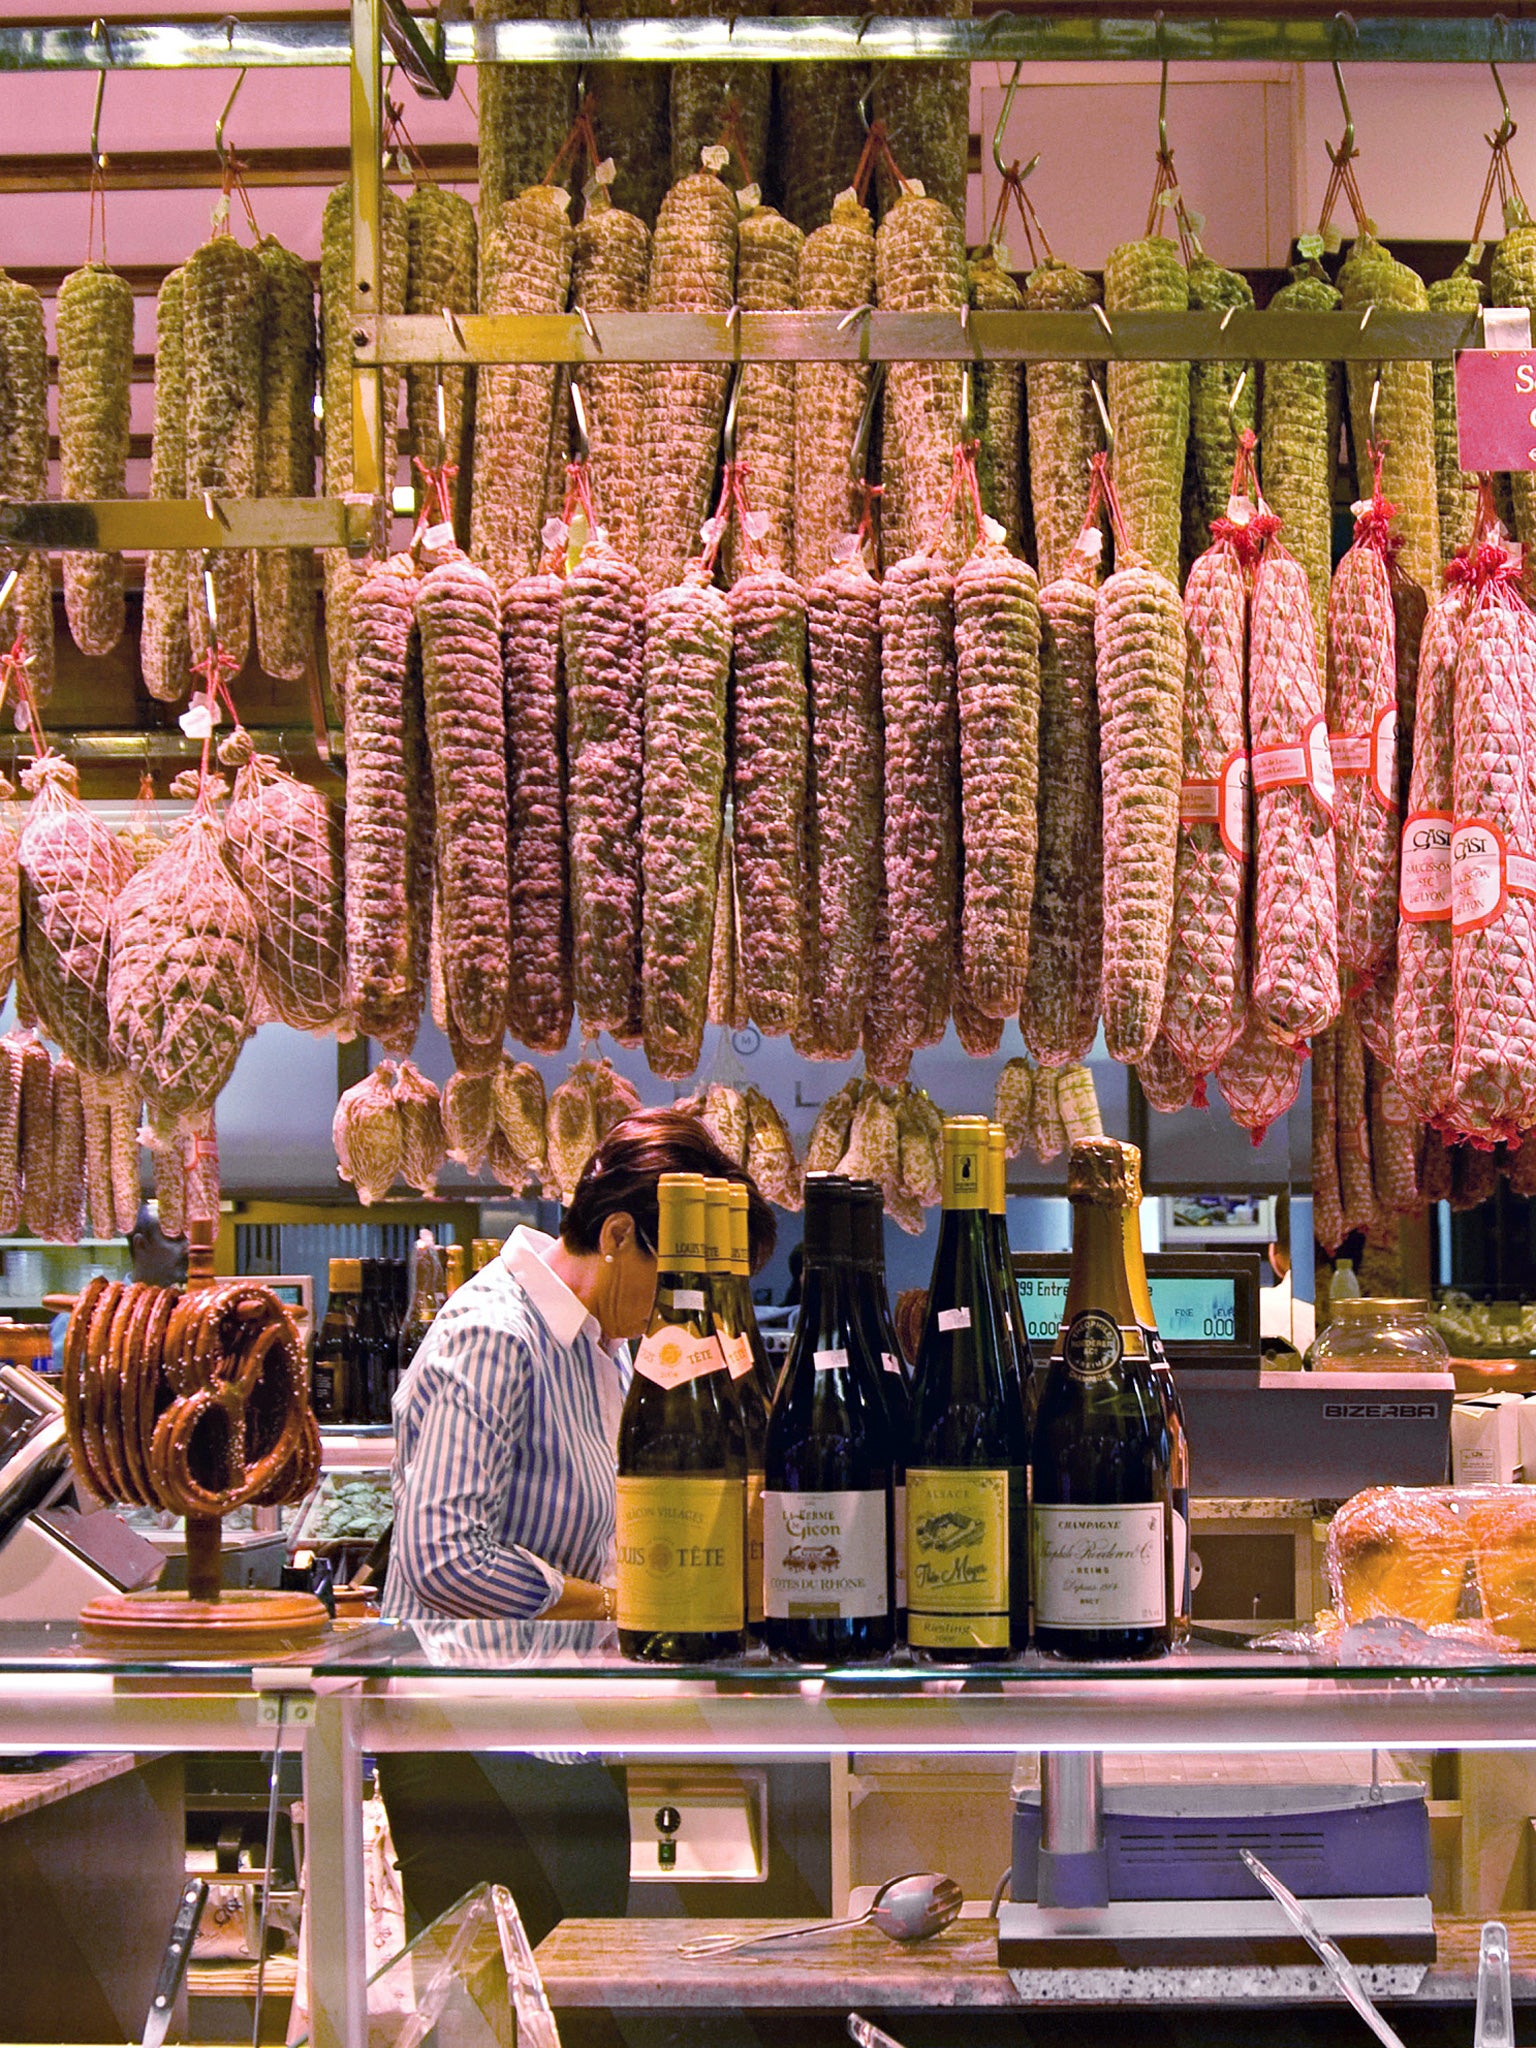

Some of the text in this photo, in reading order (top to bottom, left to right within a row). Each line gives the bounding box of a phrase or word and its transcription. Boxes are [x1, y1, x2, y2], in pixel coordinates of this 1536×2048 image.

[1515, 364, 1536, 393] S
[1016, 1281, 1033, 1296] 99
[1324, 1405, 1436, 1418] BIZERBA
[1058, 1520, 1121, 1530] CHAMPAGNE
[616, 1545, 725, 1567] OUIS TÊTE
